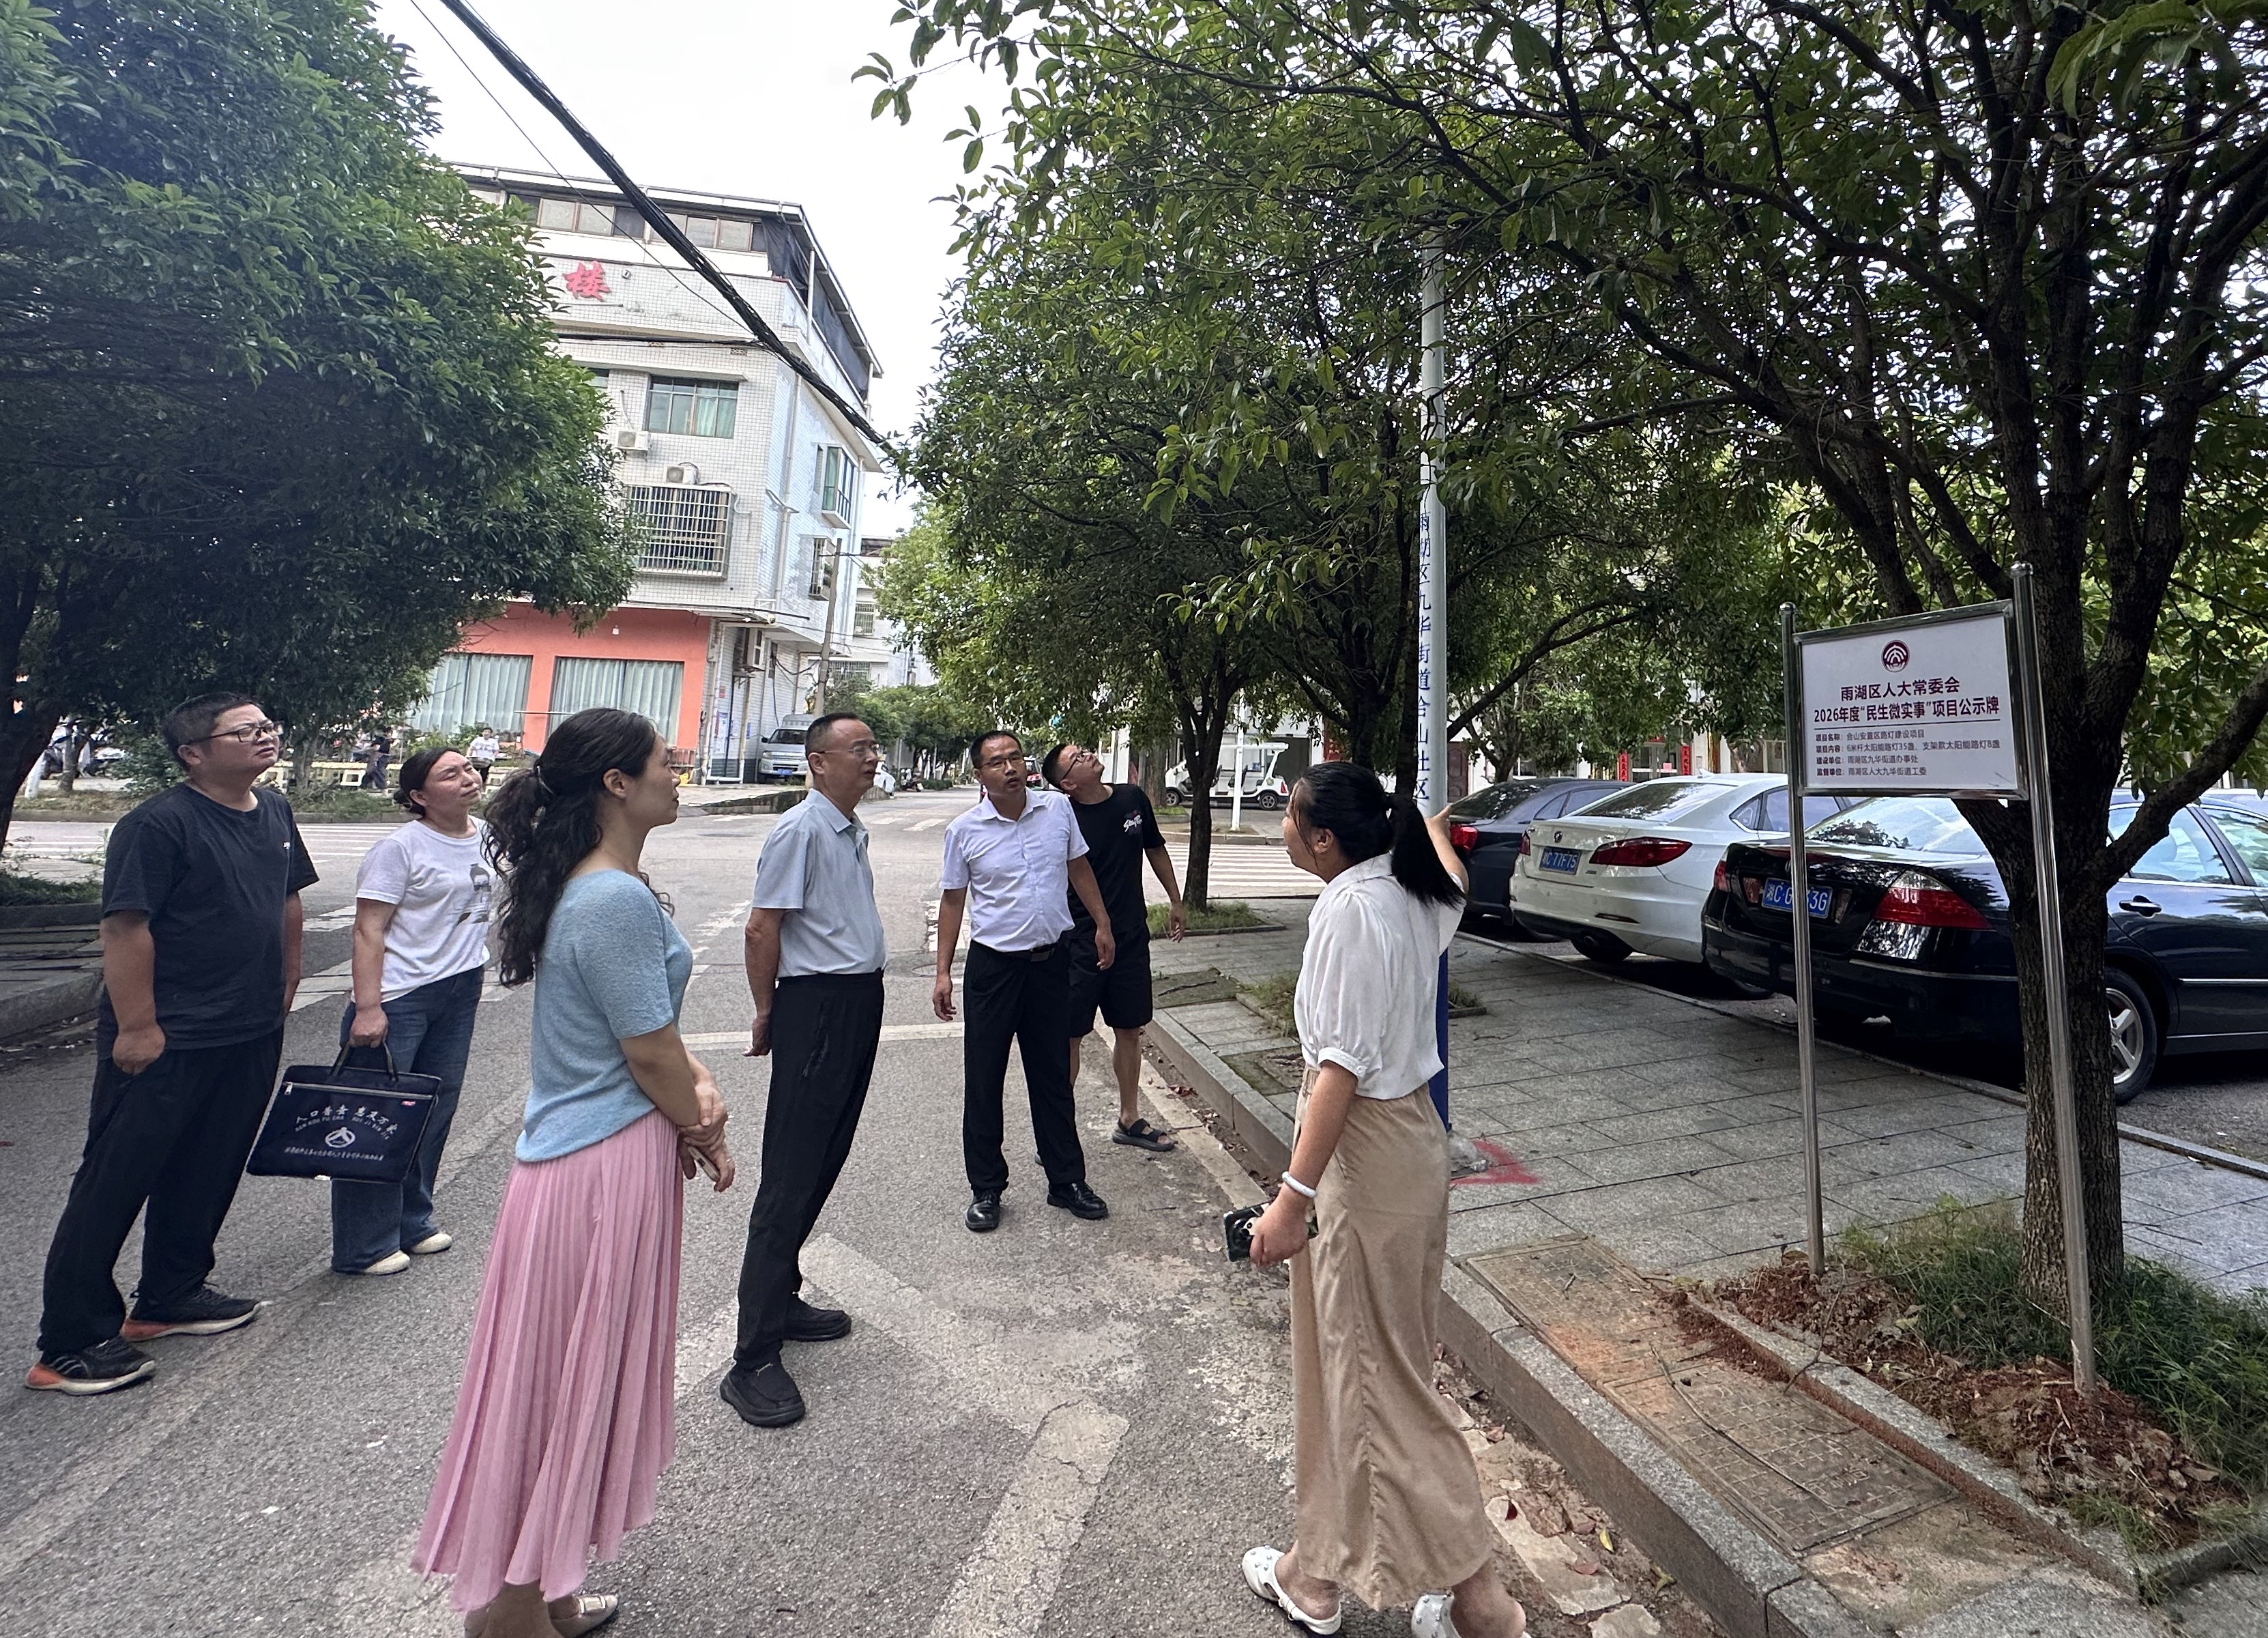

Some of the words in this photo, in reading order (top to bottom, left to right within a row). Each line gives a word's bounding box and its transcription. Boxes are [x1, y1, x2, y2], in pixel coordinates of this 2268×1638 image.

[562, 261, 611, 302] 楼
[1841, 676, 1960, 702] 雨湖区人大常委会
